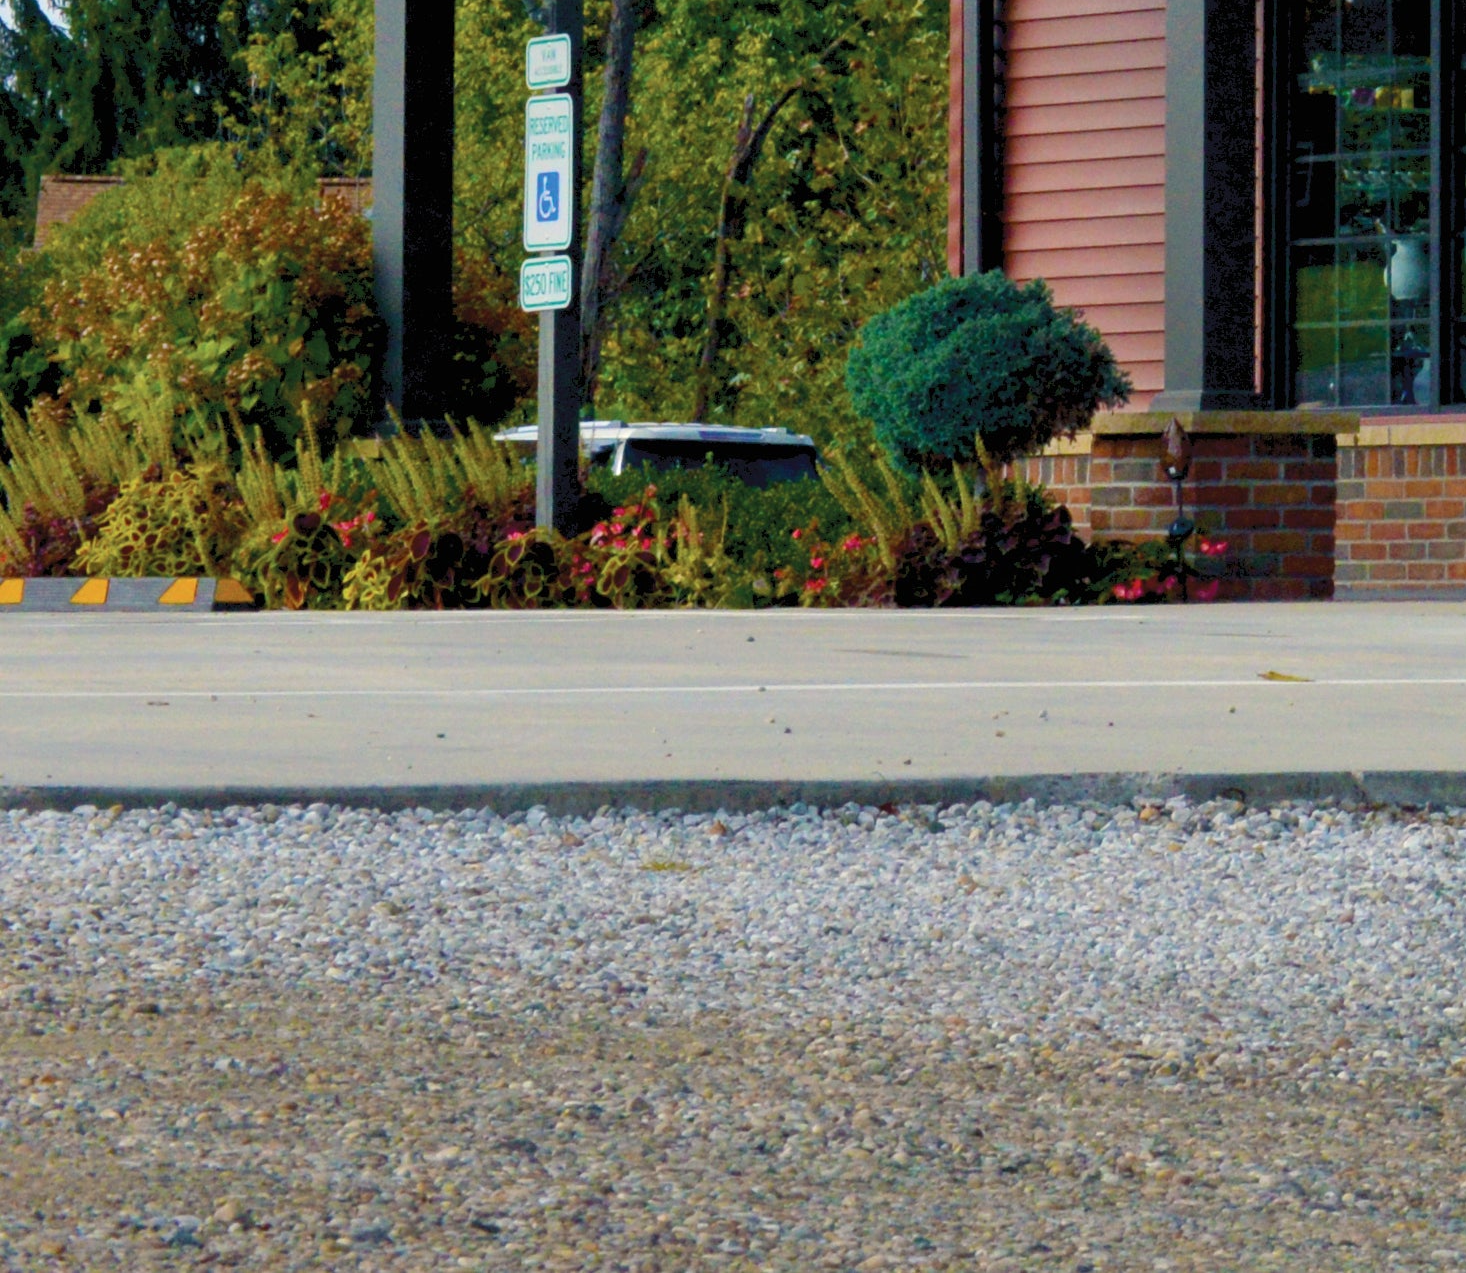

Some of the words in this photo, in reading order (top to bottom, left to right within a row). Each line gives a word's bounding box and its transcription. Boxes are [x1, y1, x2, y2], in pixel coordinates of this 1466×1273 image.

[529, 114, 569, 135] RESERVED
[531, 141, 566, 161] PARKING
[524, 273, 547, 296] $250
[549, 269, 568, 295] FINE
